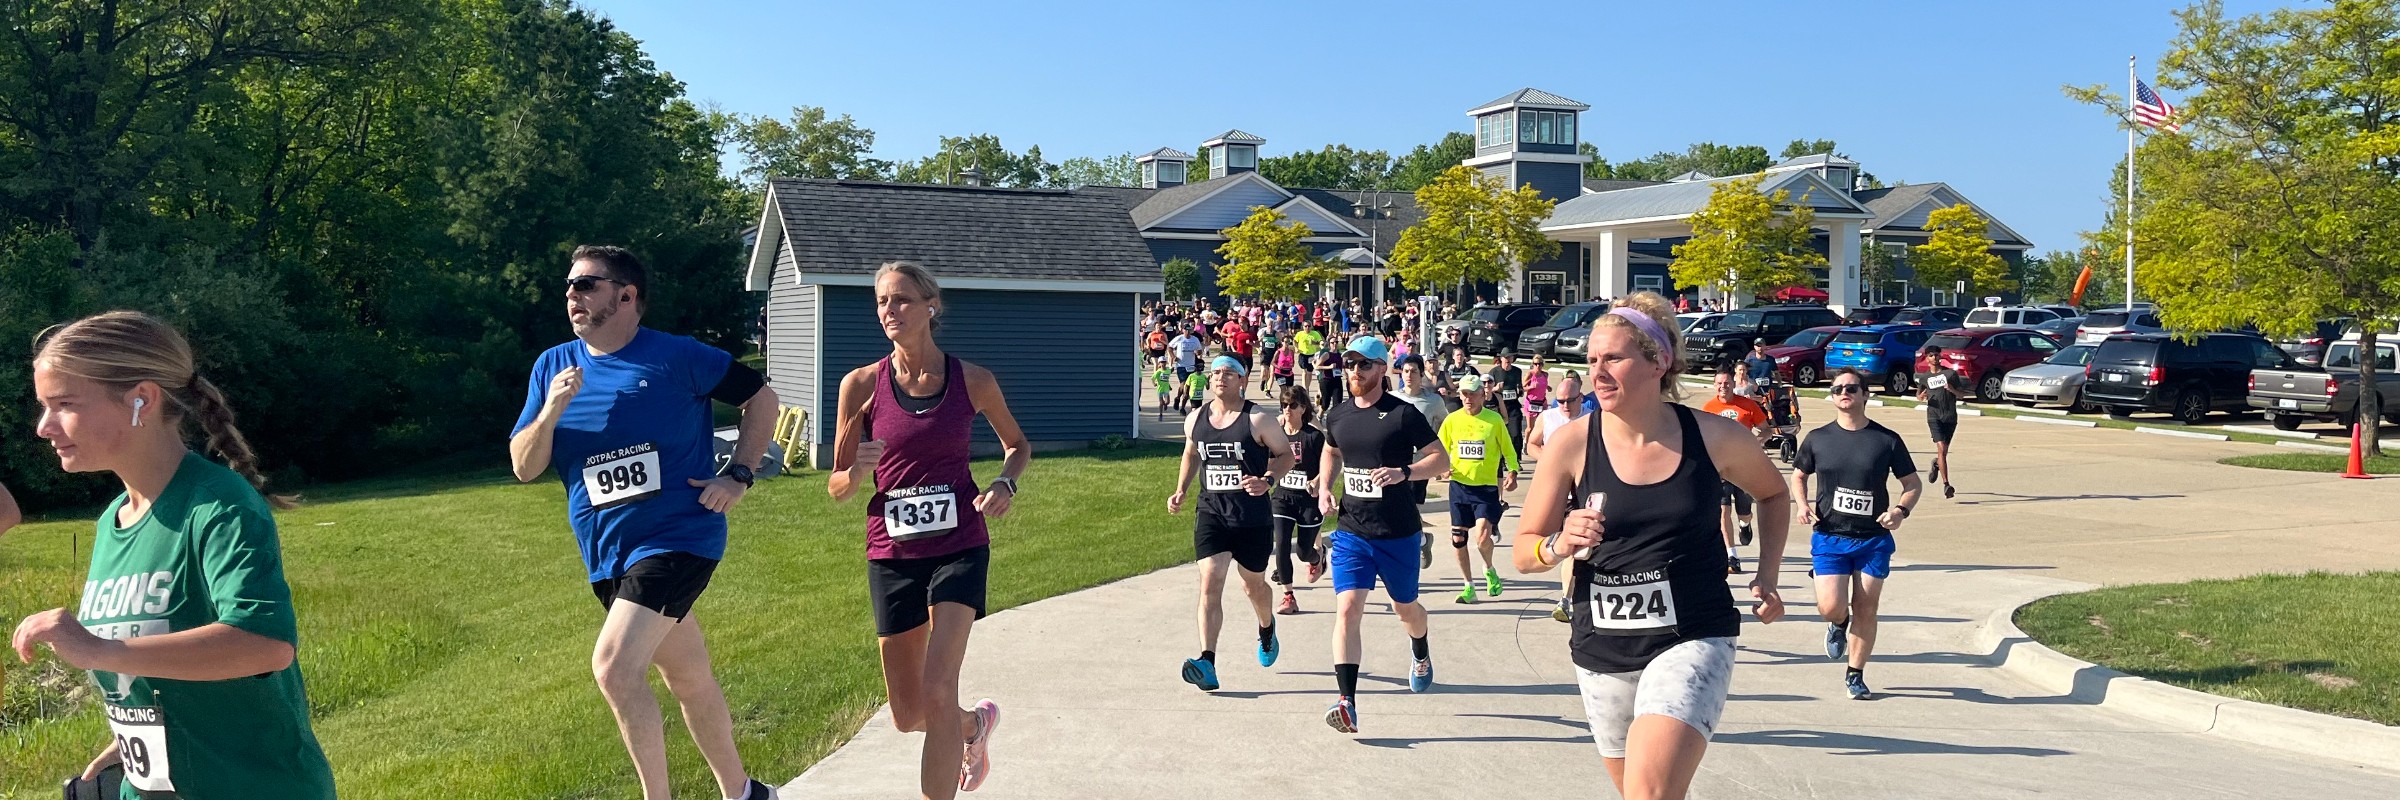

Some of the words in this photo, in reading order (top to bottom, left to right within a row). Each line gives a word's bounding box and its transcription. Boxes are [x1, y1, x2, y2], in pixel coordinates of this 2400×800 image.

[618, 443, 651, 458] RACING
[1460, 446, 1483, 456] 1098
[597, 461, 648, 495] 998
[1209, 474, 1240, 486] 1375
[1283, 475, 1304, 487] 1371
[1349, 477, 1374, 493] 983
[918, 484, 950, 495] RACING
[1837, 496, 1872, 512] 1367
[889, 499, 950, 528] 1337
[1622, 570, 1661, 584] RACING
[78, 570, 173, 621] AGONS
[1593, 589, 1668, 620] 1224
[116, 708, 156, 723] RACING
